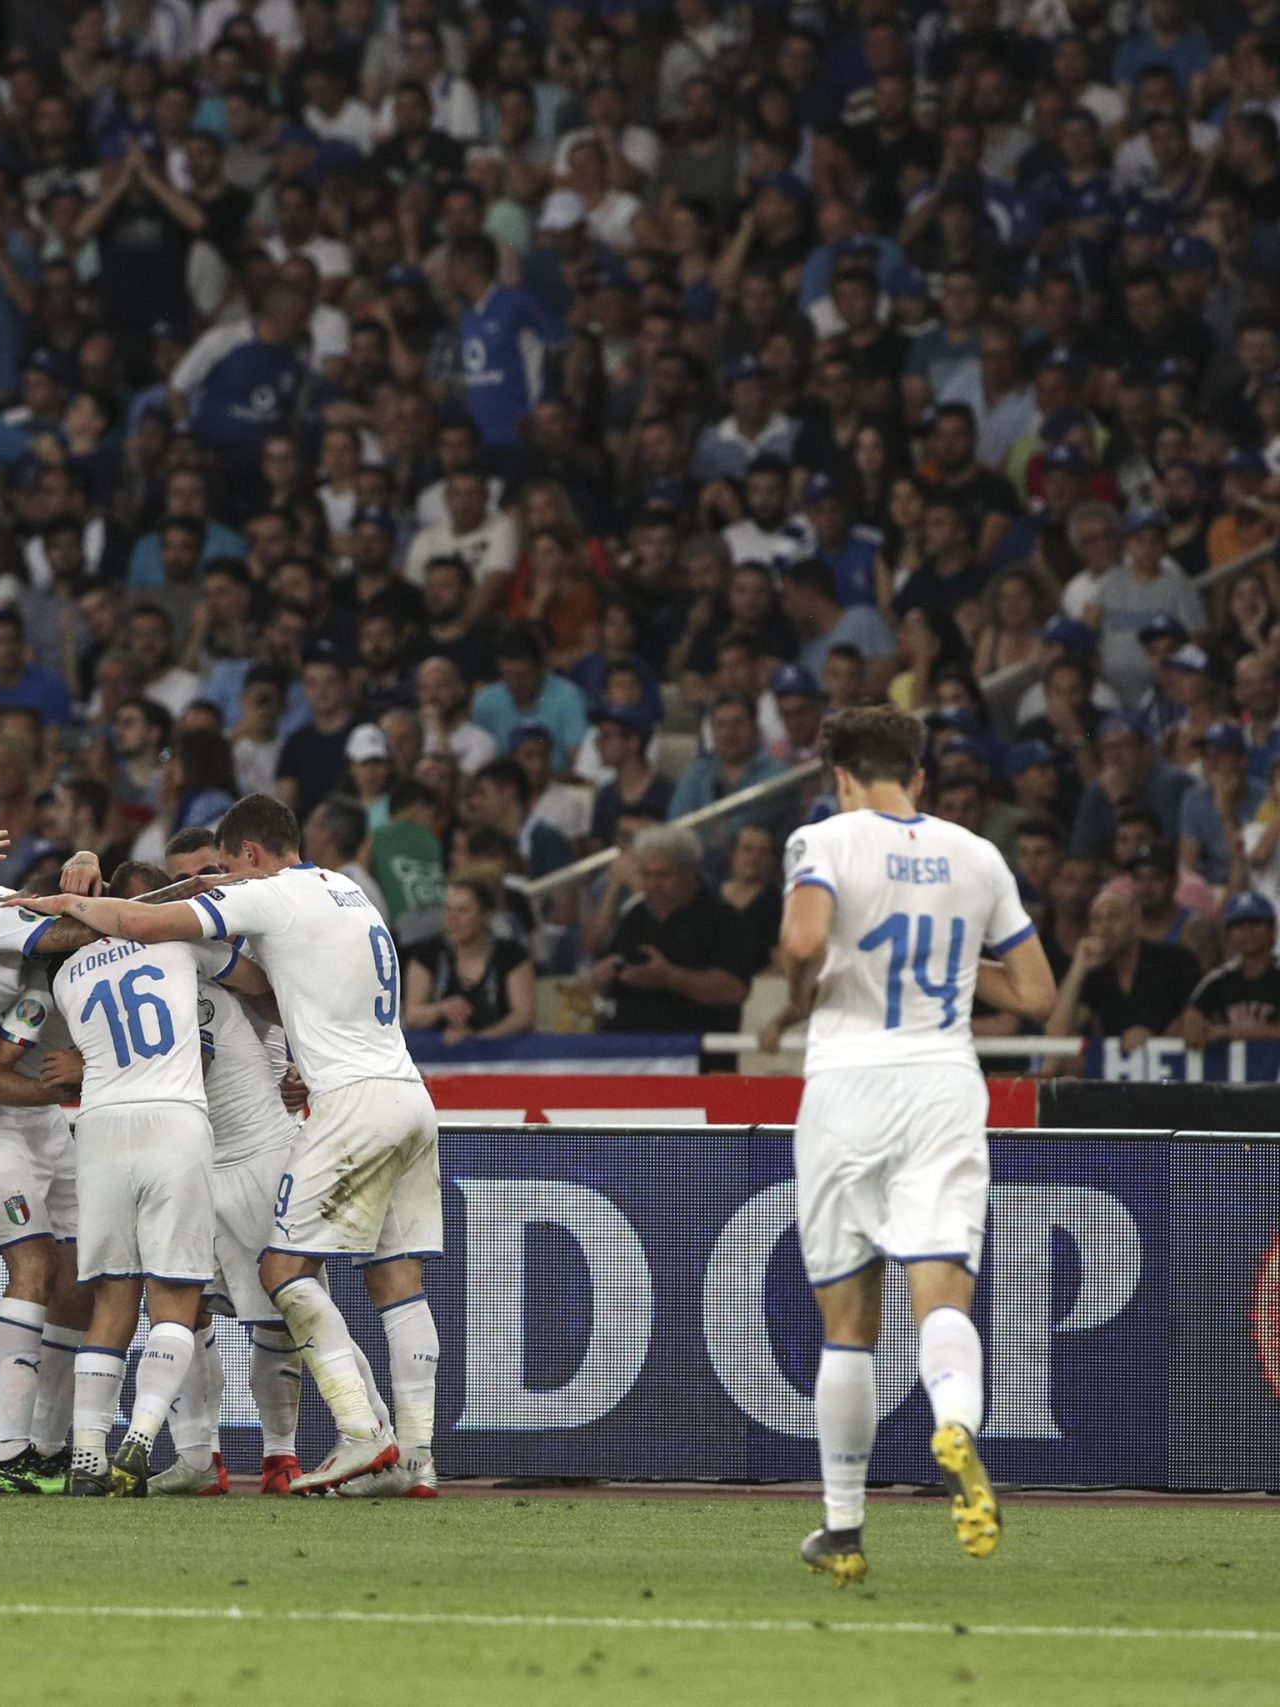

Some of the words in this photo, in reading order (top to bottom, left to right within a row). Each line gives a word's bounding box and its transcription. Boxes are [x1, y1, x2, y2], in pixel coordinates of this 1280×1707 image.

[886, 852, 951, 885] CHESA
[80, 964, 176, 1069] 16
[368, 924, 398, 1027] 9
[857, 912, 965, 1030] 14
[273, 1172, 294, 1219] 9
[143, 1350, 175, 1362] TALIA
[452, 1178, 1142, 1440] DOP
